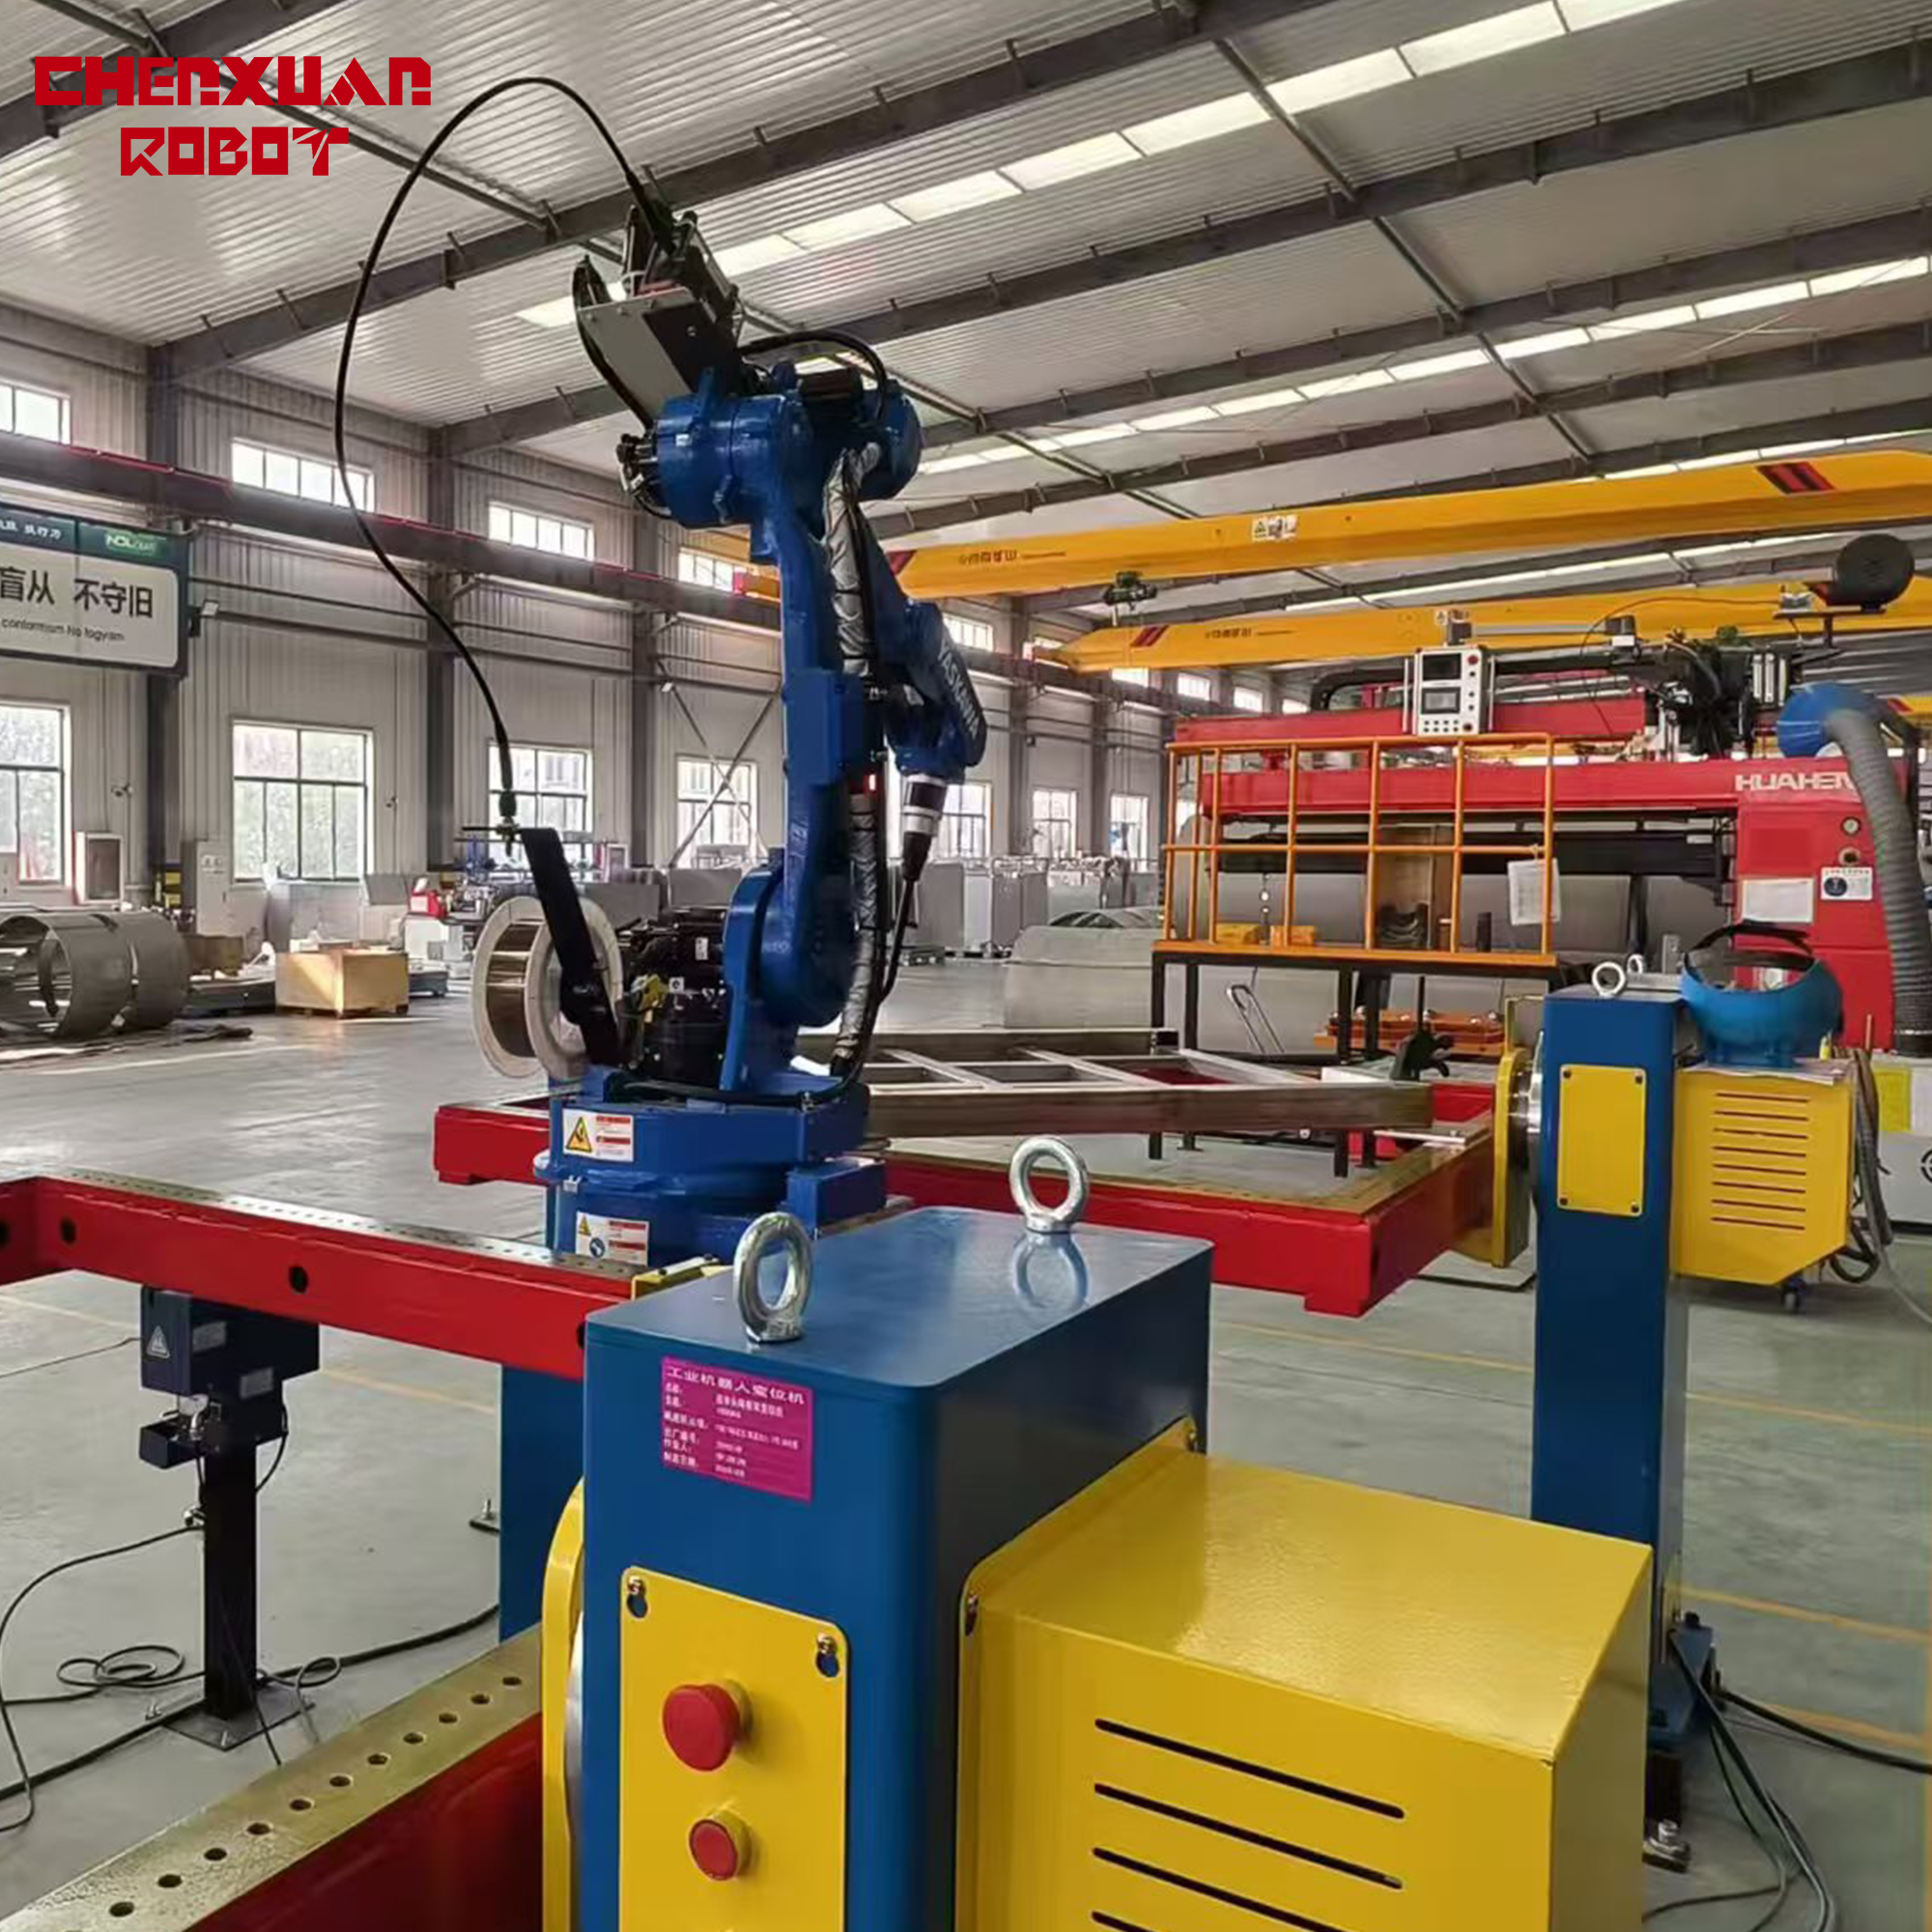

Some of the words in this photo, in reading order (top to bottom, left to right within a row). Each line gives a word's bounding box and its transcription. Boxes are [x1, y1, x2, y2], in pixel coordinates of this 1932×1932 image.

[0, 565, 55, 606] 盲从
[73, 578, 154, 619] 不守旧
[937, 638, 980, 740] YASKAWA
